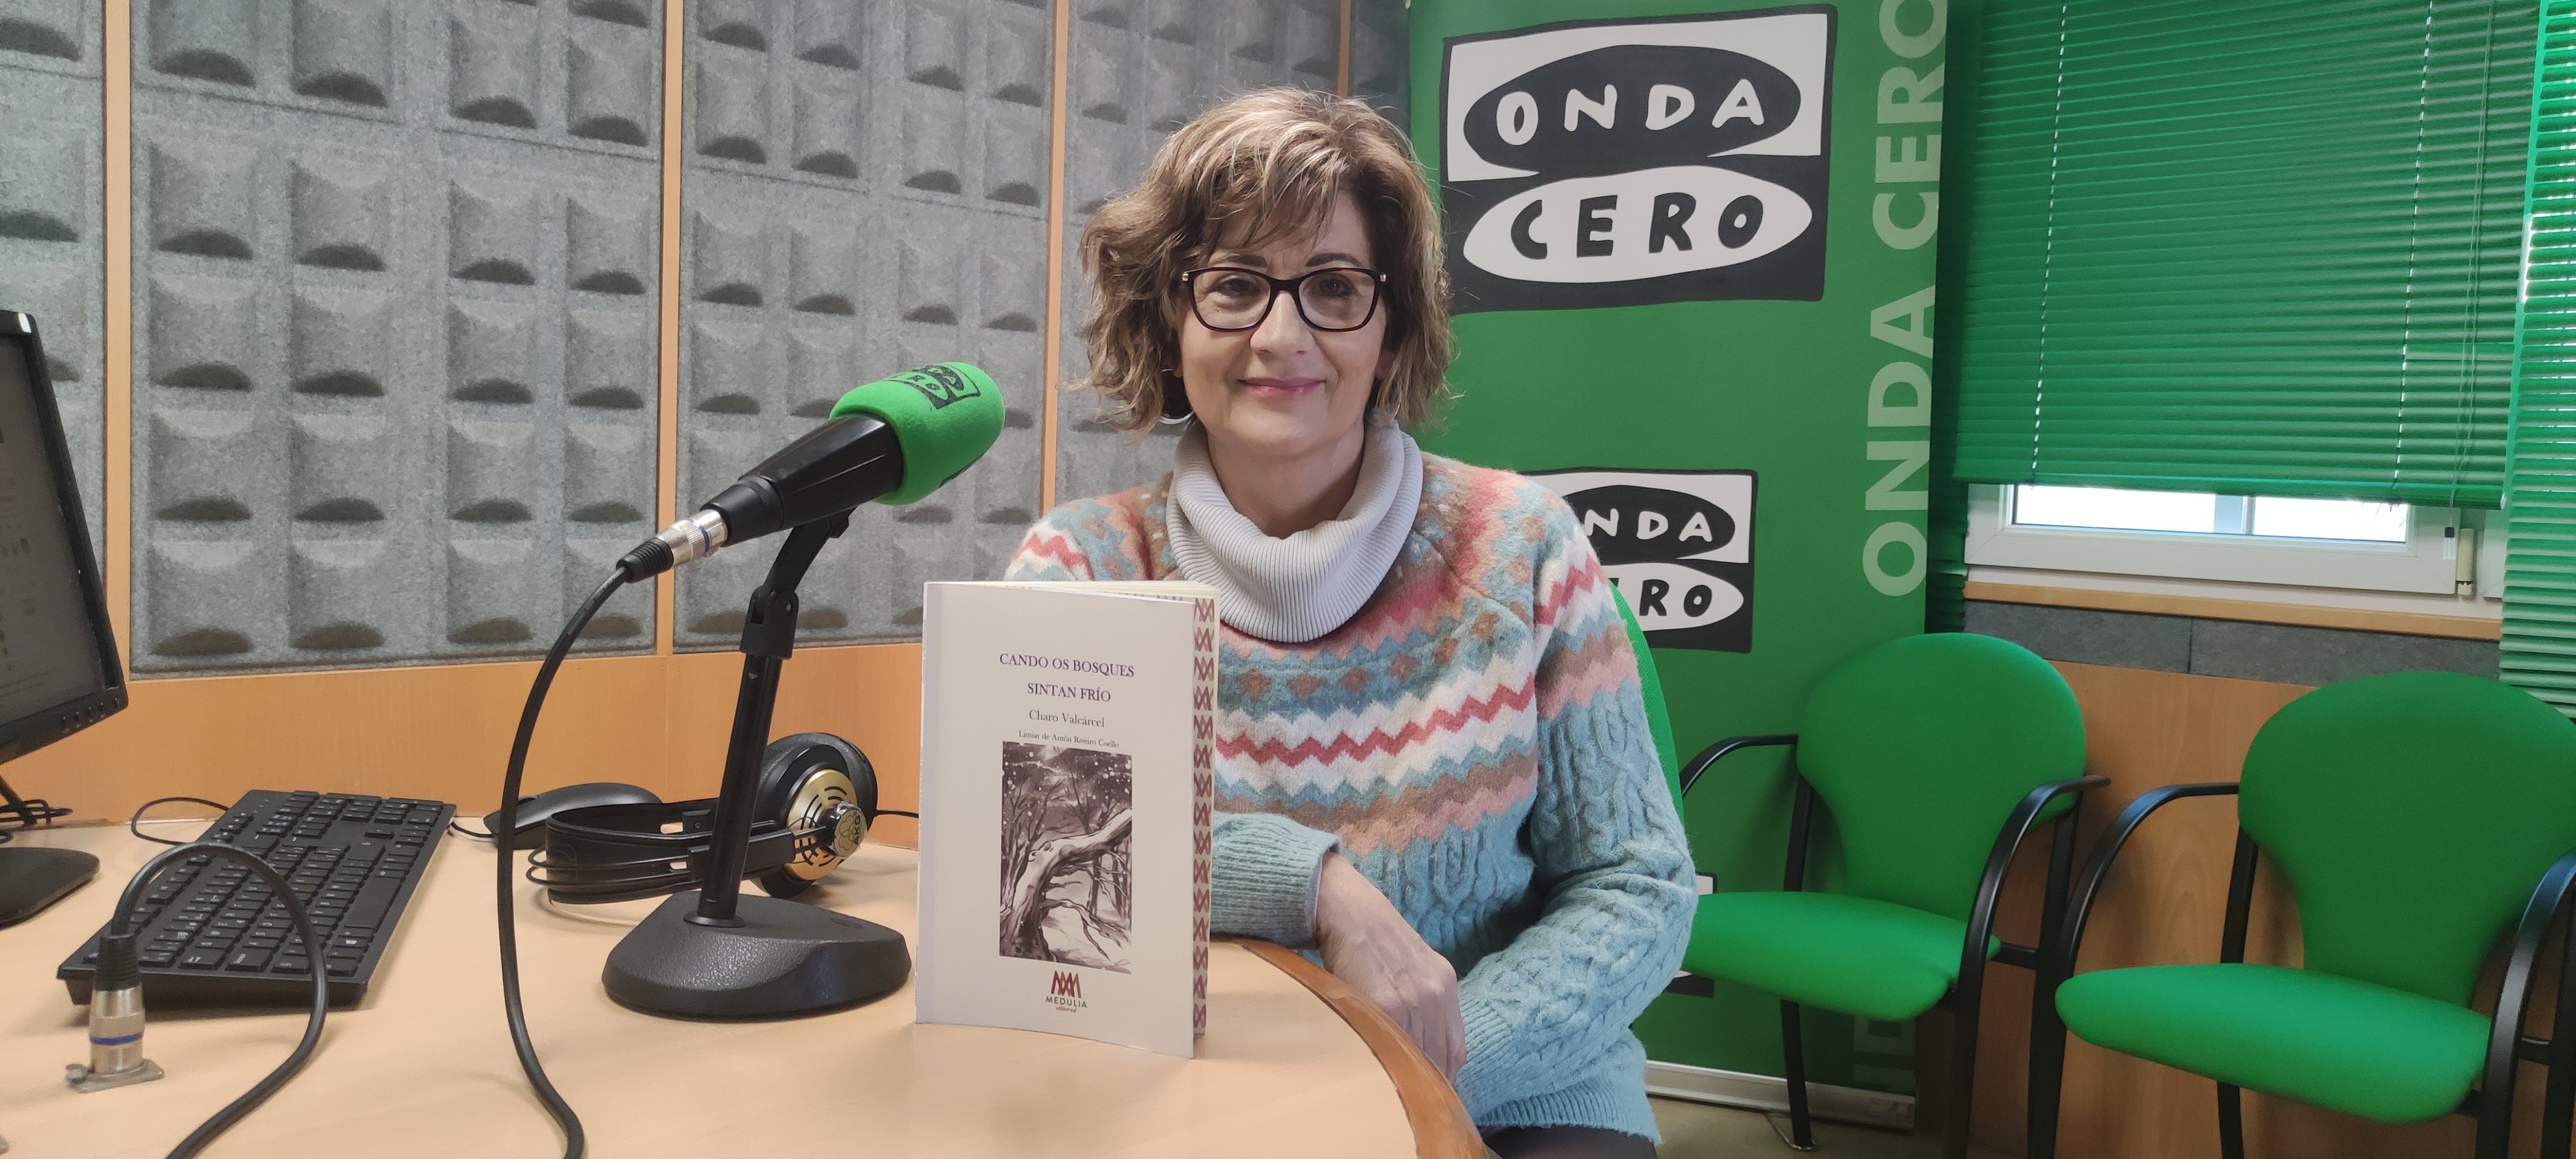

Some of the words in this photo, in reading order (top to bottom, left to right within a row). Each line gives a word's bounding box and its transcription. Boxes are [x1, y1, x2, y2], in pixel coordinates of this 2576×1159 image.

[1496, 78, 1764, 145] ONDA
[1872, 0, 1948, 250] CERO
[1511, 192, 1764, 260] CERO
[1862, 285, 1936, 597] ONDA
[1581, 508, 1713, 542] NDA
[1608, 577, 1713, 617] RO
[999, 653, 1048, 668] CANDO
[1052, 658, 1069, 670] OS
[1073, 659, 1134, 677] BOSQUES
[1028, 682, 1076, 698] SINTAN
[1080, 687, 1111, 702] FRÍO
[1029, 709, 1059, 722] Charo
[1062, 713, 1105, 727] Valcárcel
[1052, 734, 1072, 742] Antón
[1098, 739, 1120, 748] Coello
[1045, 996, 1088, 1008] MEDULIA
